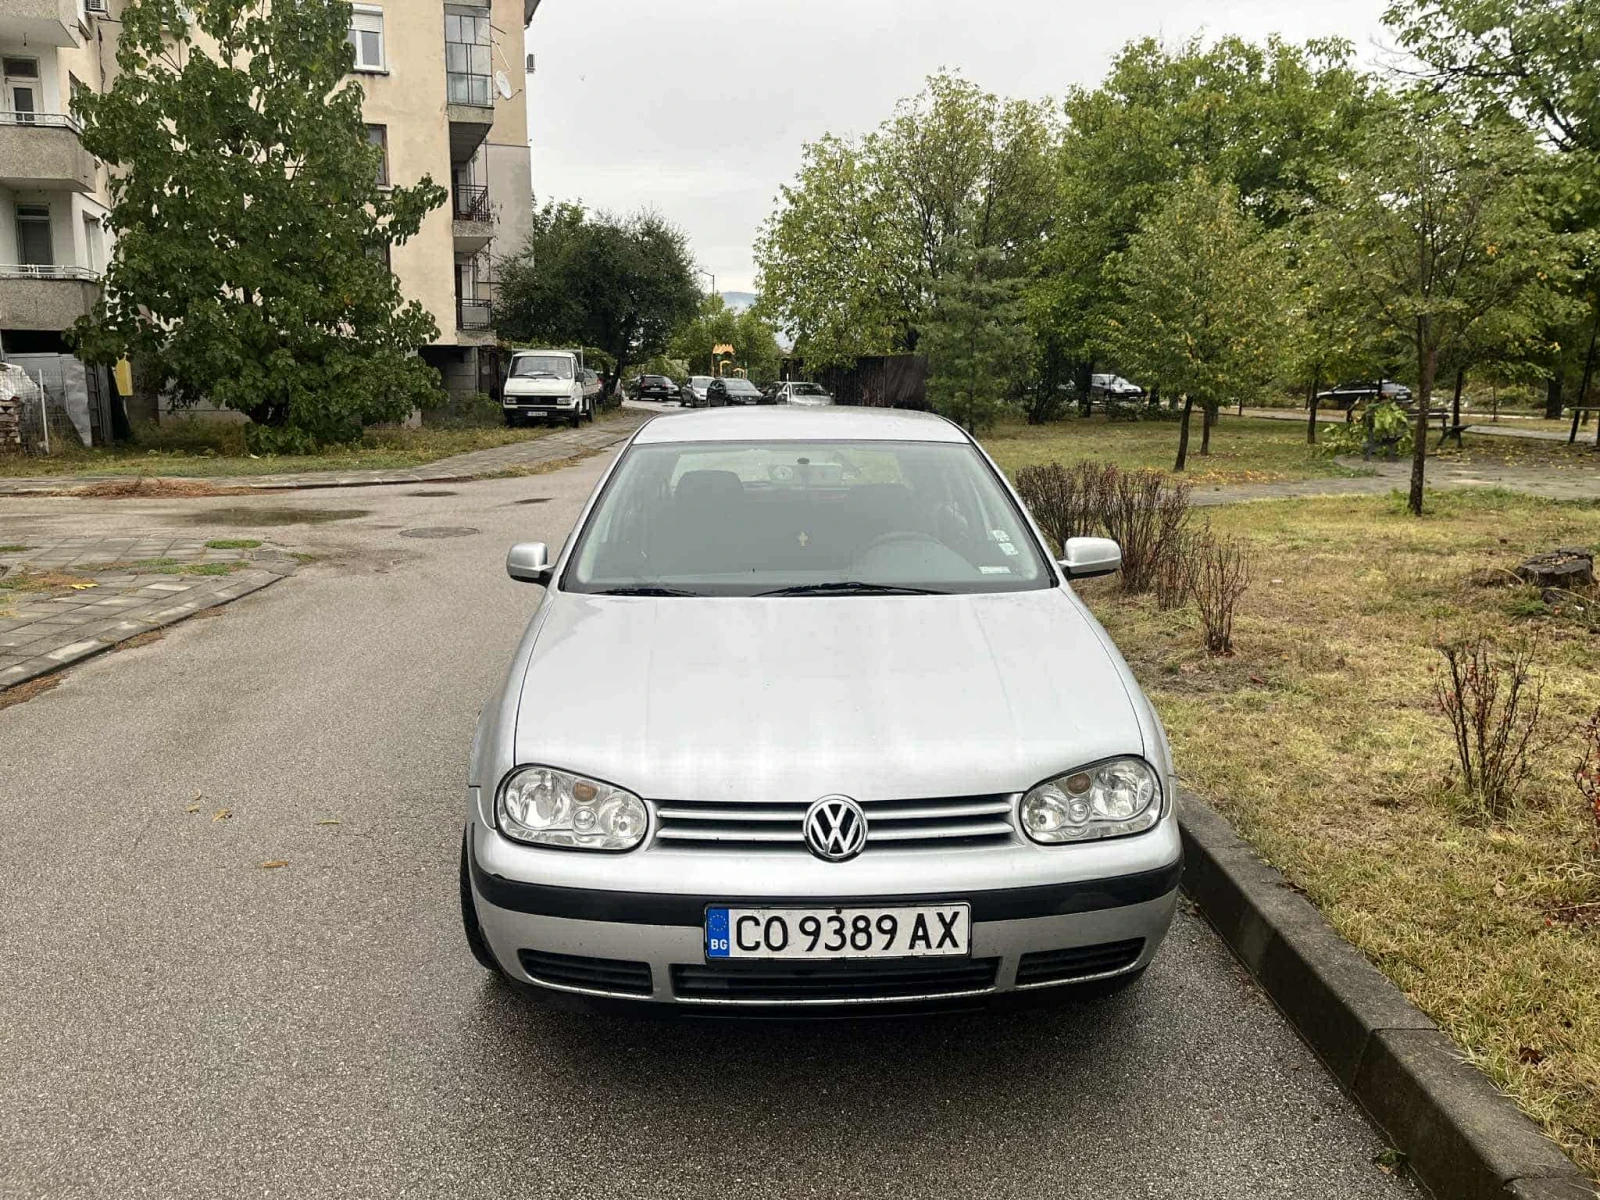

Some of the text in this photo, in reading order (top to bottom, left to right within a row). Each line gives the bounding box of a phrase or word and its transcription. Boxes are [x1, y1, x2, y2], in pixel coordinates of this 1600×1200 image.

[710, 938, 728, 949] BG
[736, 911, 960, 951] CO 9389 AX
